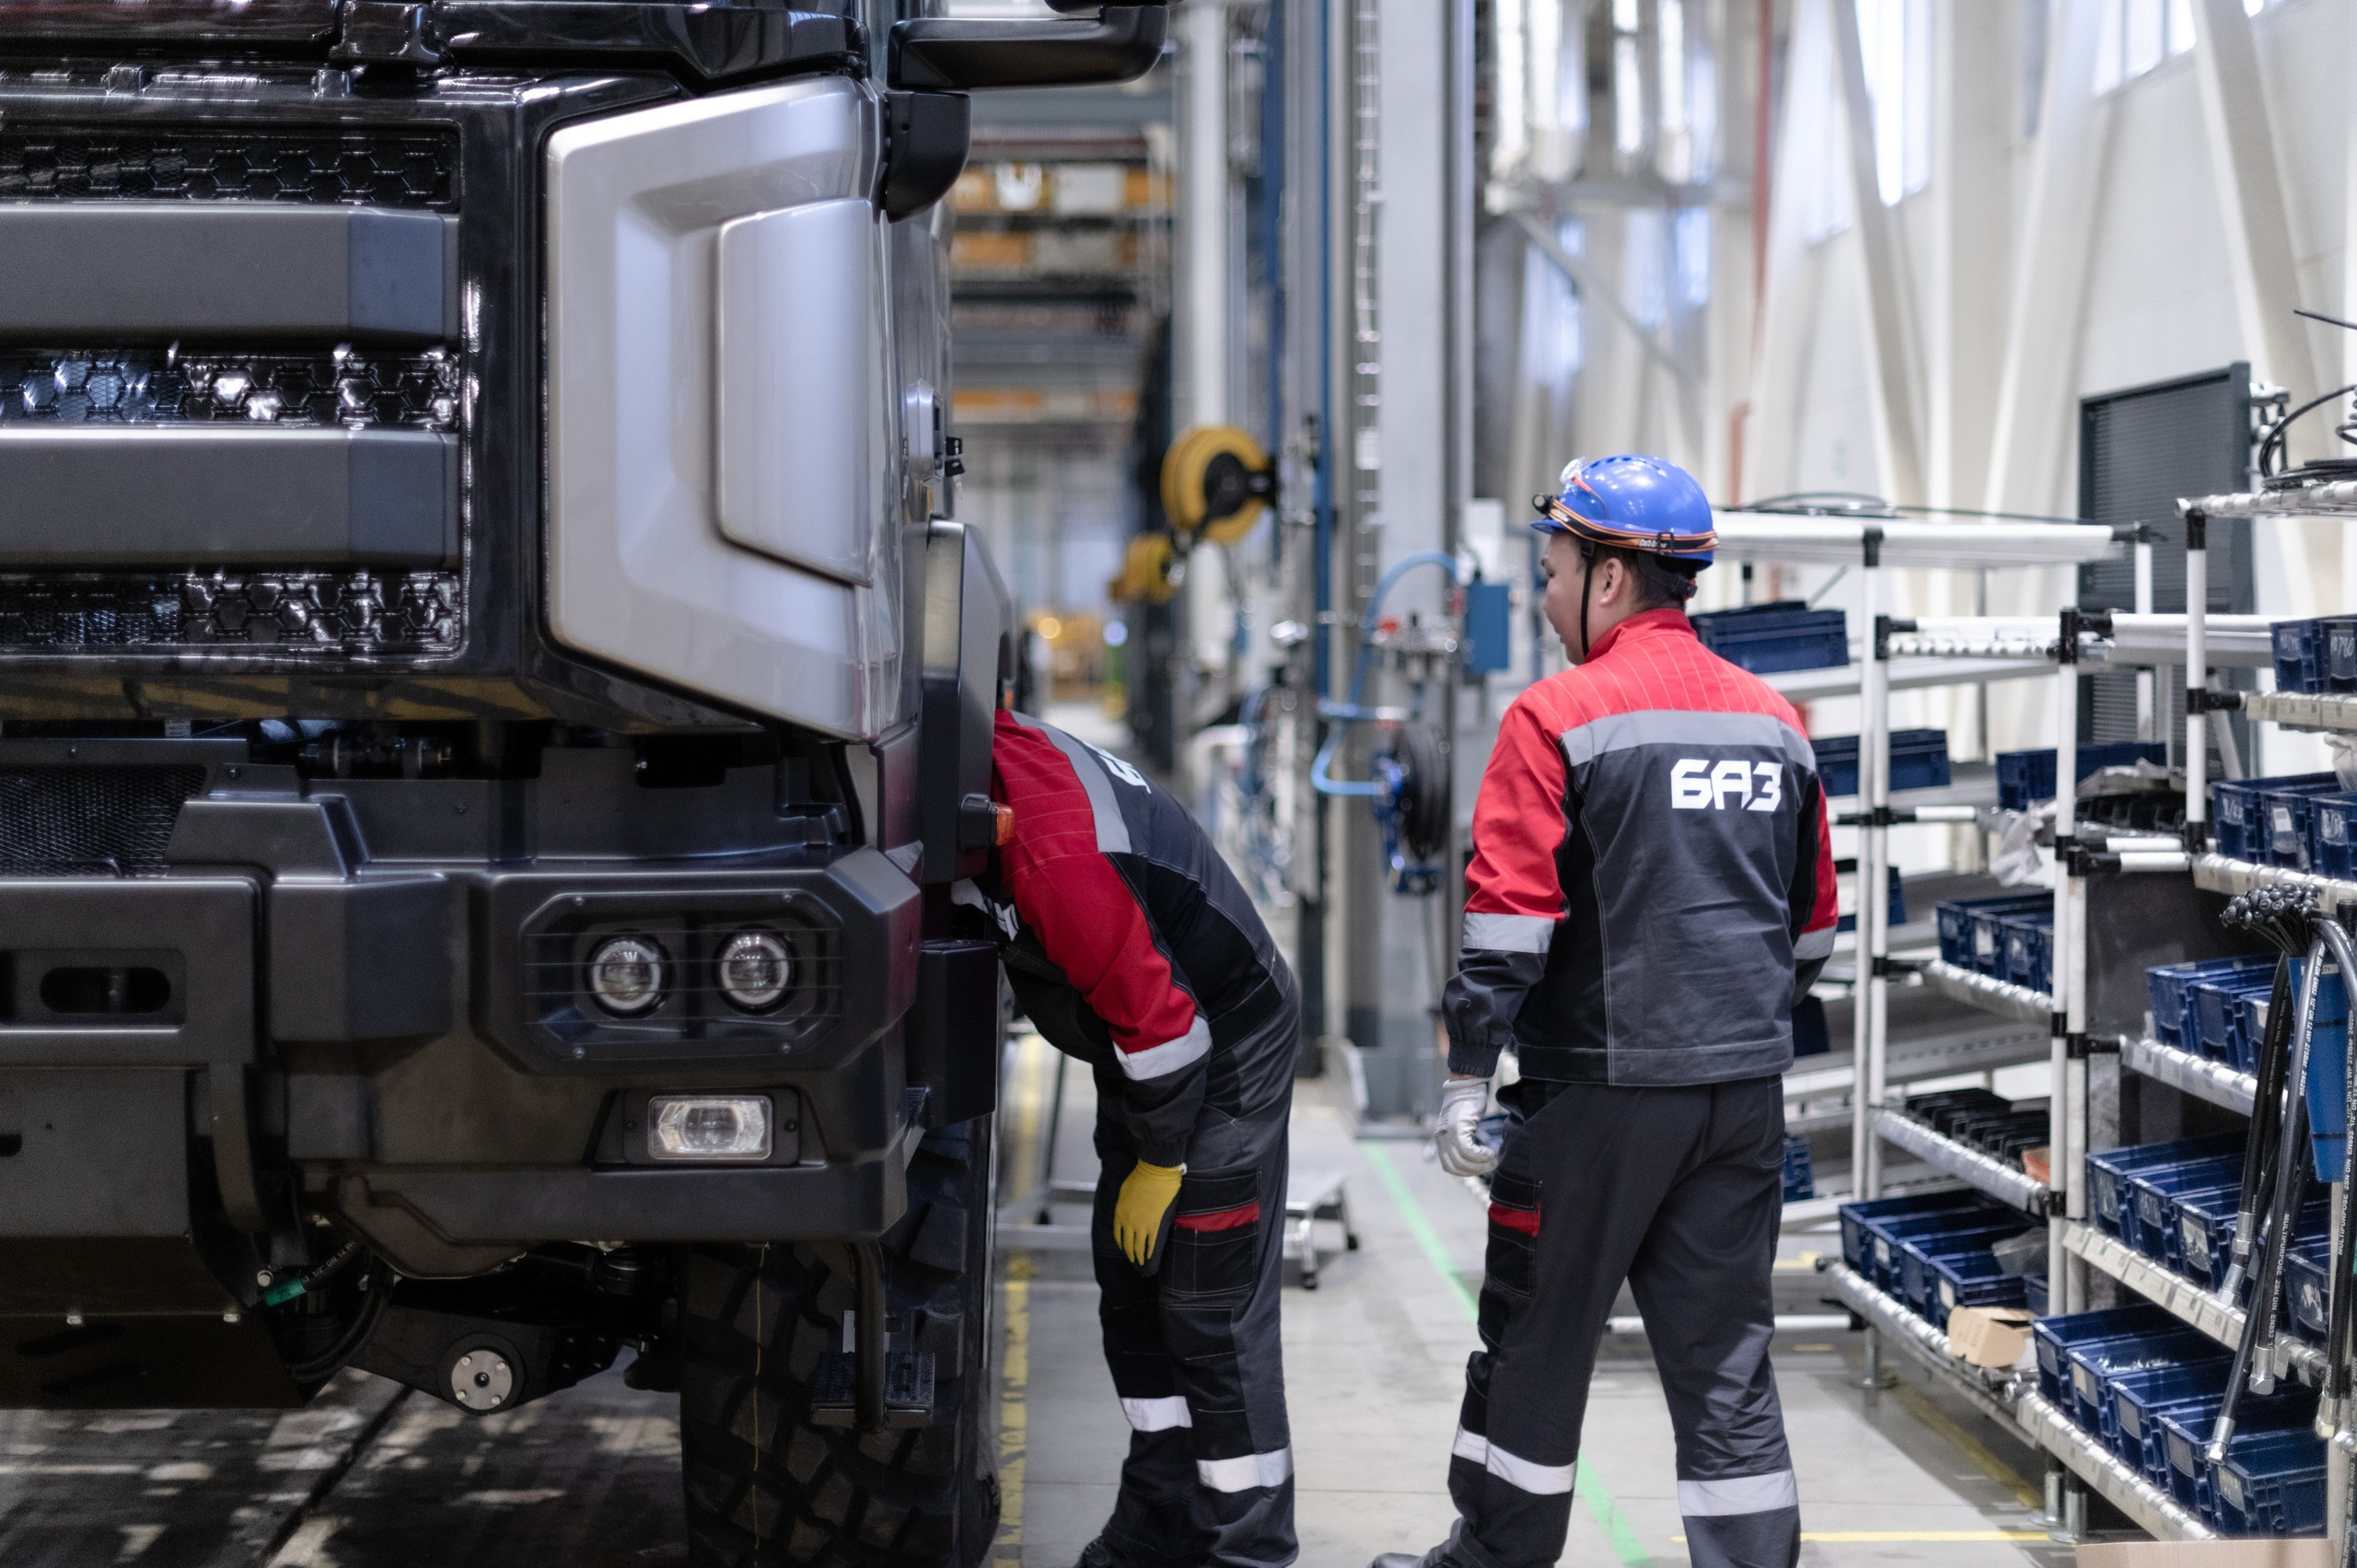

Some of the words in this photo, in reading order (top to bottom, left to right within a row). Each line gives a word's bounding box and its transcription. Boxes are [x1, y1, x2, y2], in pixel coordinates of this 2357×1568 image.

[1671, 759, 1782, 811] БАЗ
[2308, 1010, 2315, 1020] DN
[2307, 1021, 2313, 1030] 12
[2306, 1030, 2312, 1042] WP
[2347, 1065, 2352, 1078] WP
[2347, 1080, 2352, 1088] 12
[2346, 1092, 2351, 1102] DN
[2338, 1194, 2349, 1255] MULTIPURPOSE
[2351, 1099, 2357, 1110] DN
[2276, 1213, 2290, 1275] MULTIPURPOSE
[2272, 1279, 2281, 1295] 2SN
[2270, 1296, 2279, 1310] DIN
[2268, 1314, 2277, 1338] EN853
